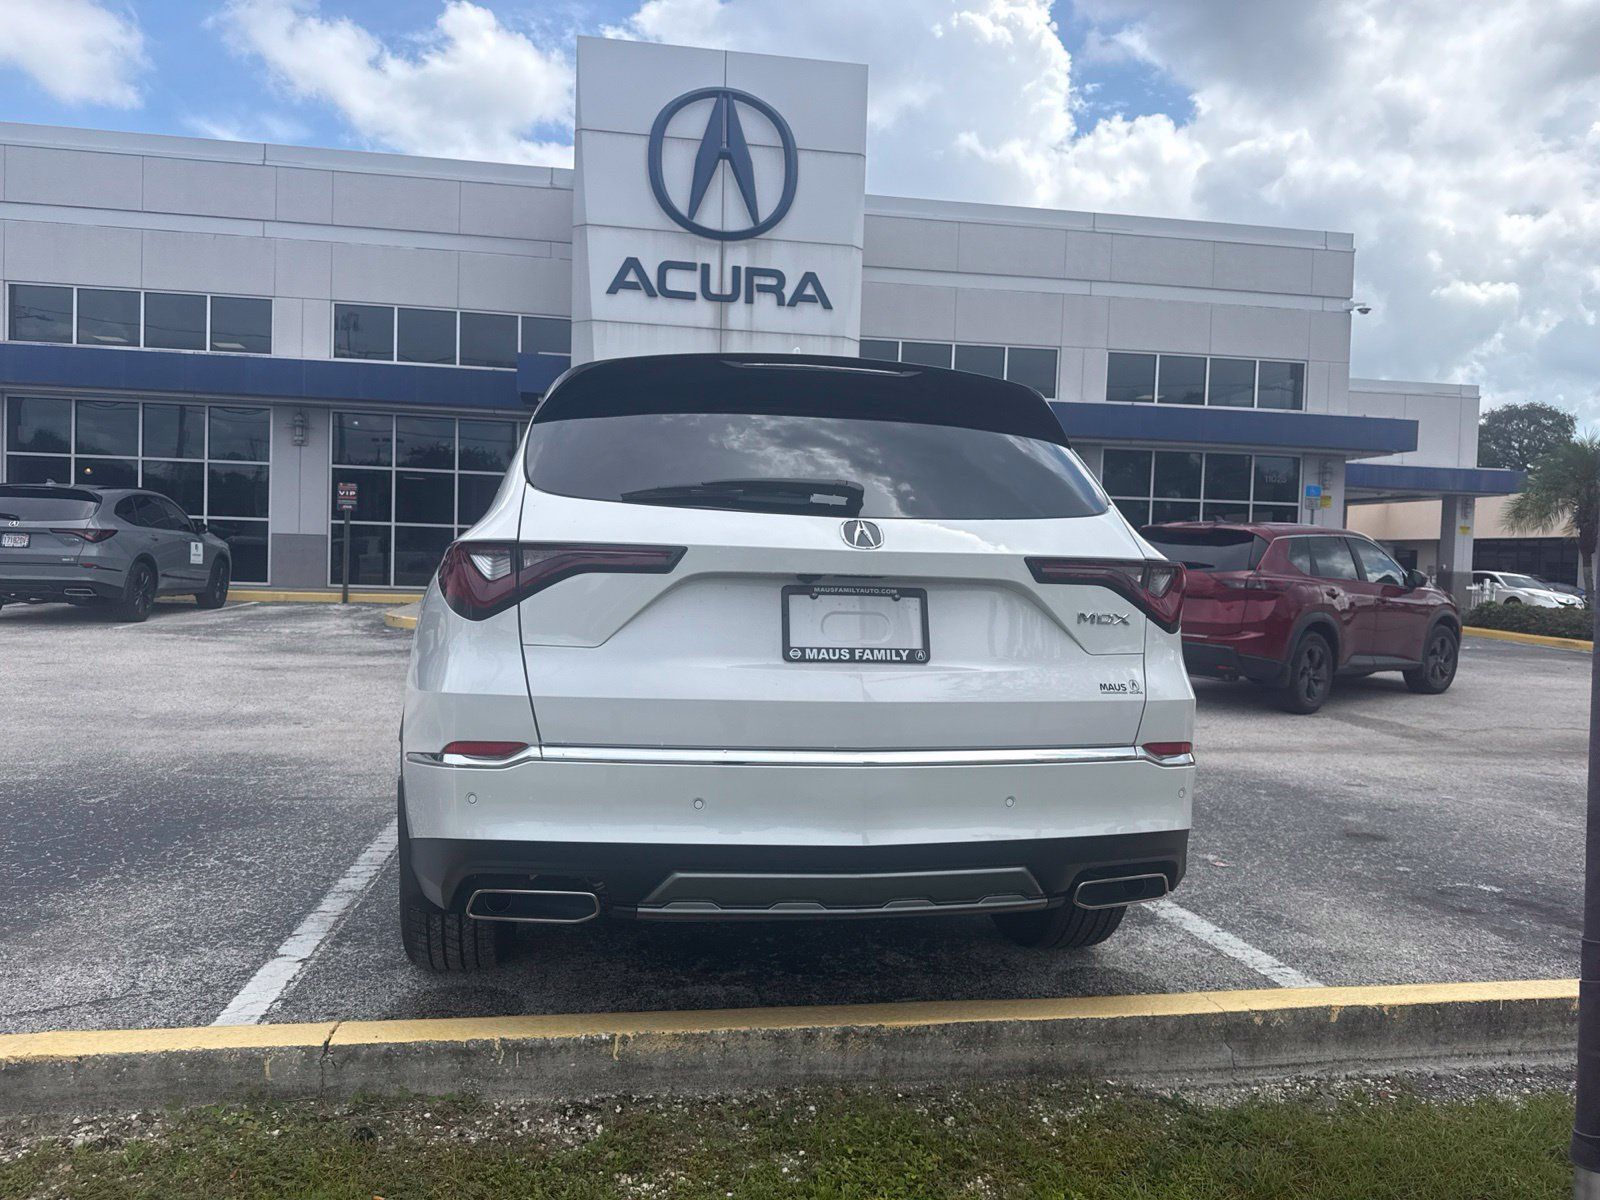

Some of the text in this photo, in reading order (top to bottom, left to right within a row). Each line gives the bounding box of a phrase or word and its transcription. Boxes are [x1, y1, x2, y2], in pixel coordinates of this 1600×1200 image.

[606, 256, 833, 310] ACURA
[813, 586, 898, 595] MAUSFAMILYAUTO.COM
[1076, 612, 1130, 626] MDX
[805, 648, 910, 661] MAUS FAMILY
[1099, 683, 1128, 692] MAUS
